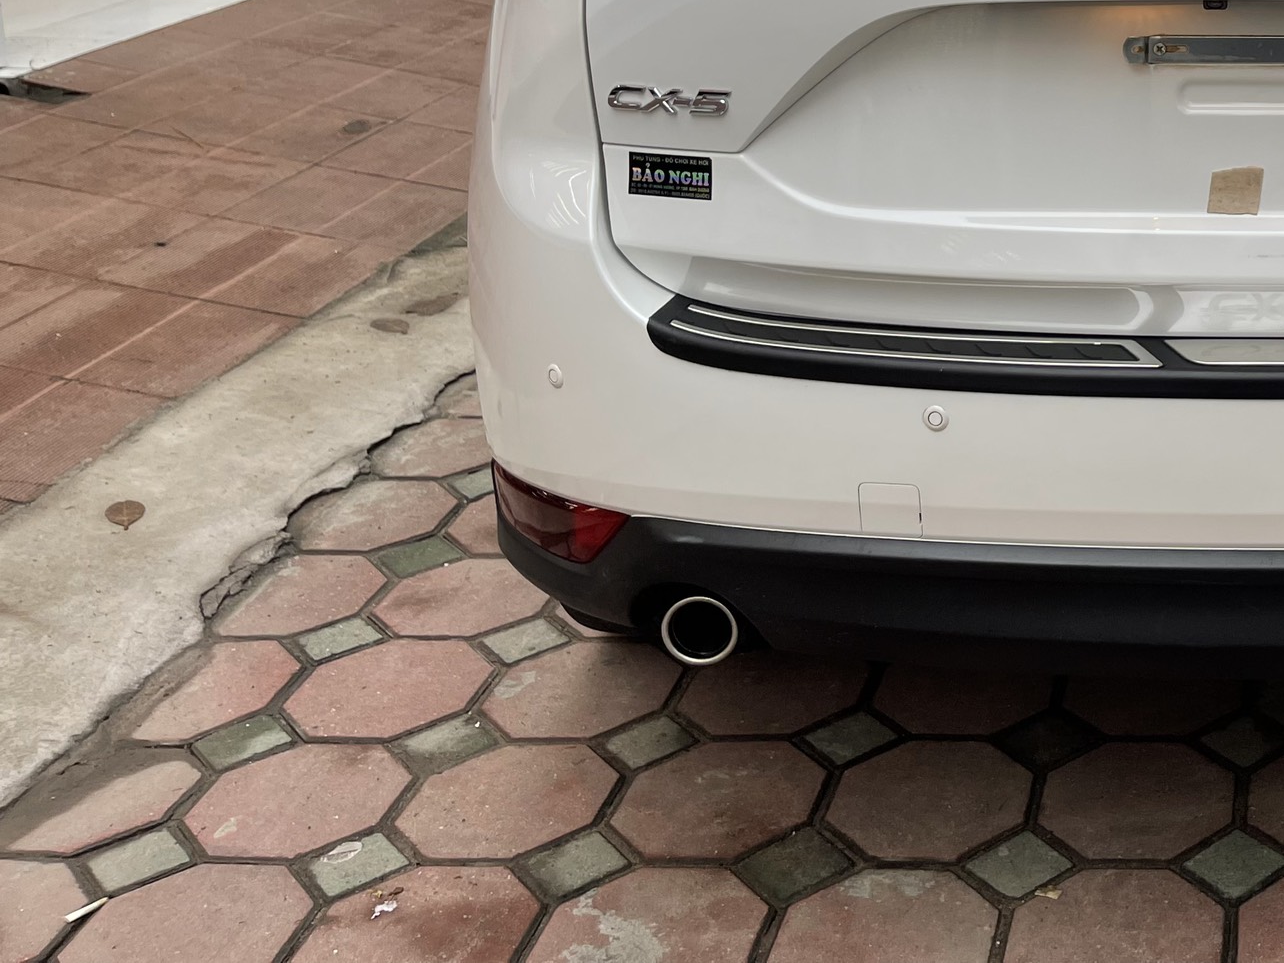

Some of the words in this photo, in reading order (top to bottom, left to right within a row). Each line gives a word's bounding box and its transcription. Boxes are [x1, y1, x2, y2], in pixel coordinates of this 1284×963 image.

[606, 84, 733, 117] CX-5
[632, 162, 666, 183] BẢO
[668, 169, 710, 186] NGHI
